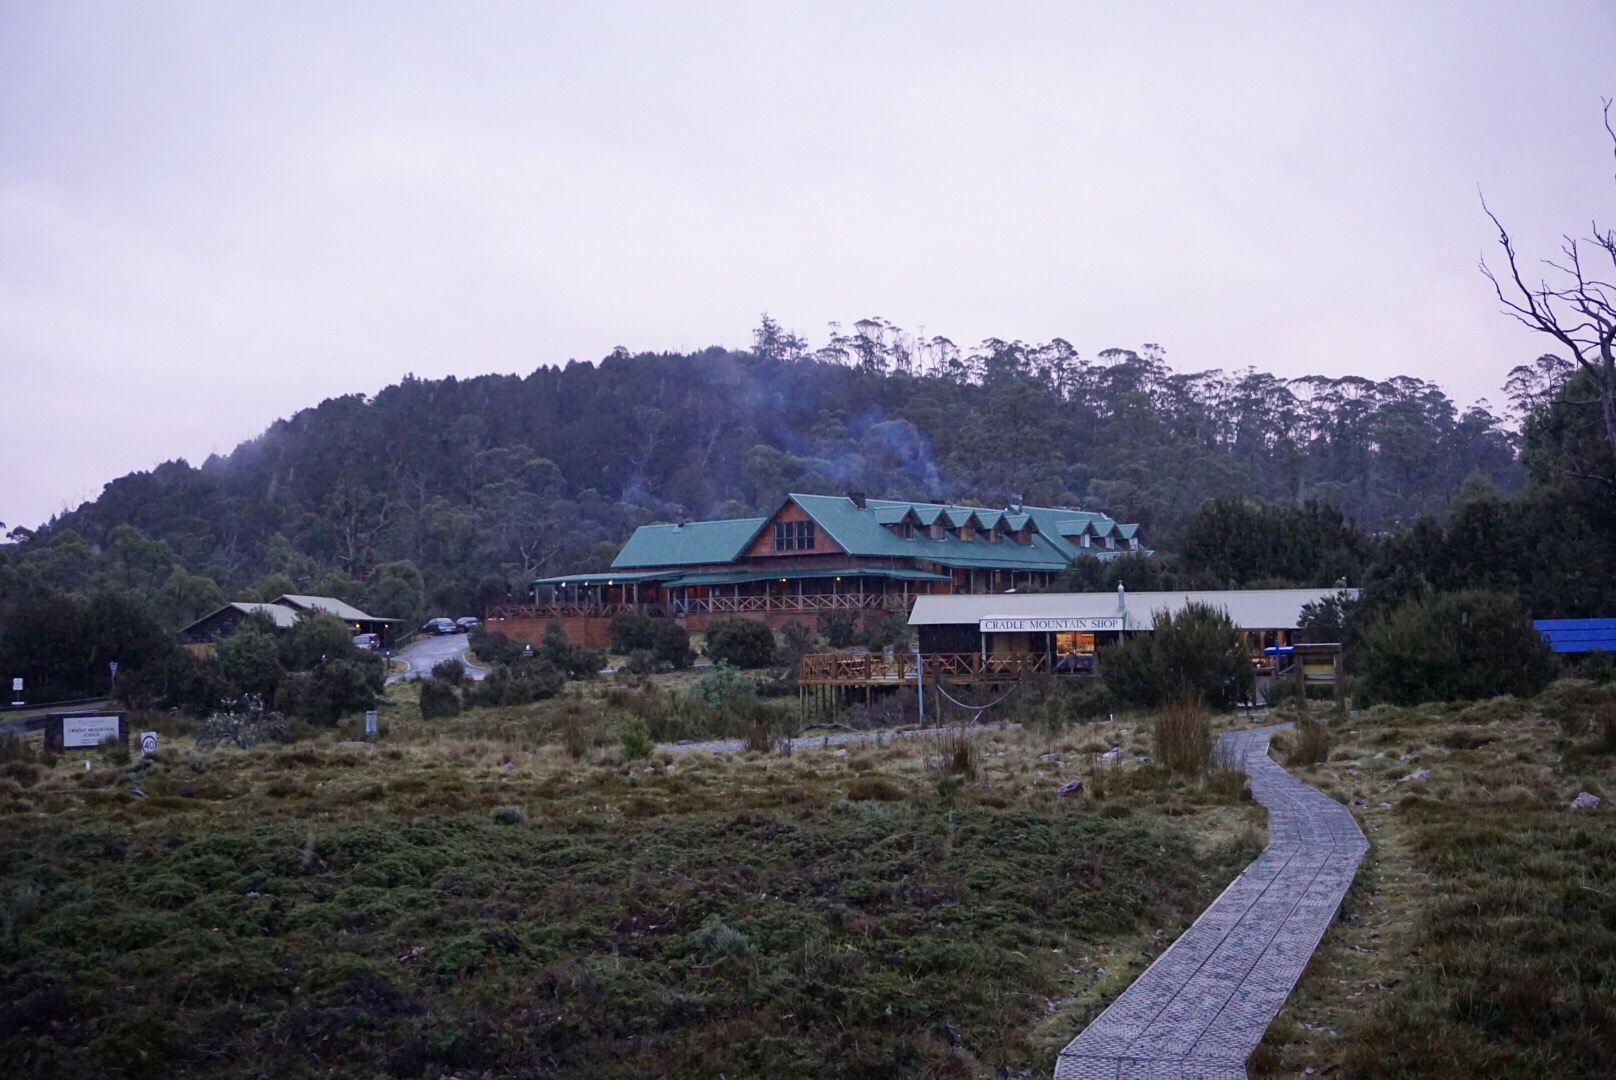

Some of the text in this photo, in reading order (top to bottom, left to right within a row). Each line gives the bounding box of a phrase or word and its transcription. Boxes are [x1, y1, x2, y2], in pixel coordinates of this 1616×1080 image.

[985, 619, 1118, 630] CRADLE MOUNTAIN SHOP
[145, 741, 154, 750] 40
